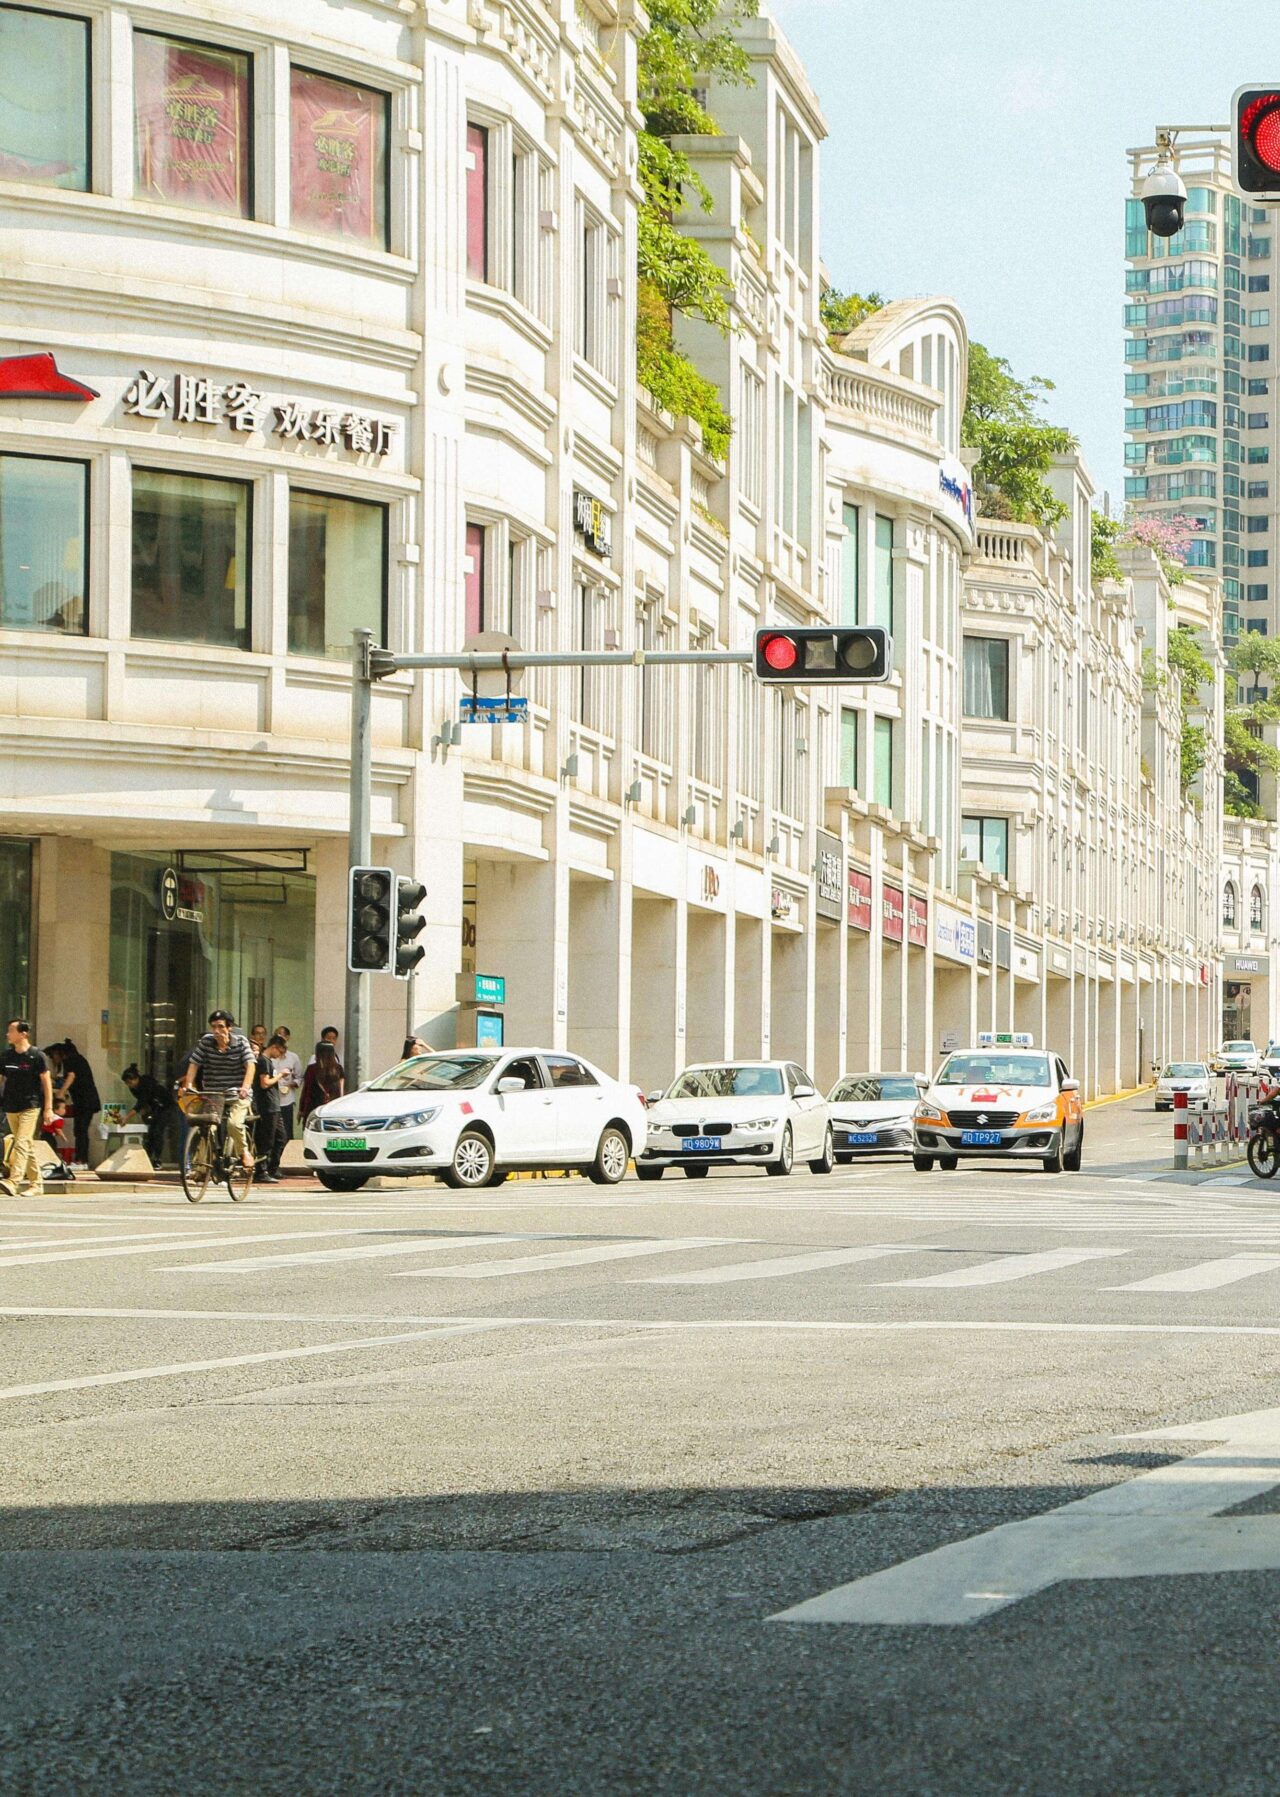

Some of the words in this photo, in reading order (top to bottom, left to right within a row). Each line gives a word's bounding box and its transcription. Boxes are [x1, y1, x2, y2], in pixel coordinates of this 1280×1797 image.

[122, 369, 269, 433] 必胜客
[271, 401, 400, 455] 欢乐餐厅
[1235, 959, 1259, 972] HUAWEI
[954, 1087, 1024, 1098] TAXI
